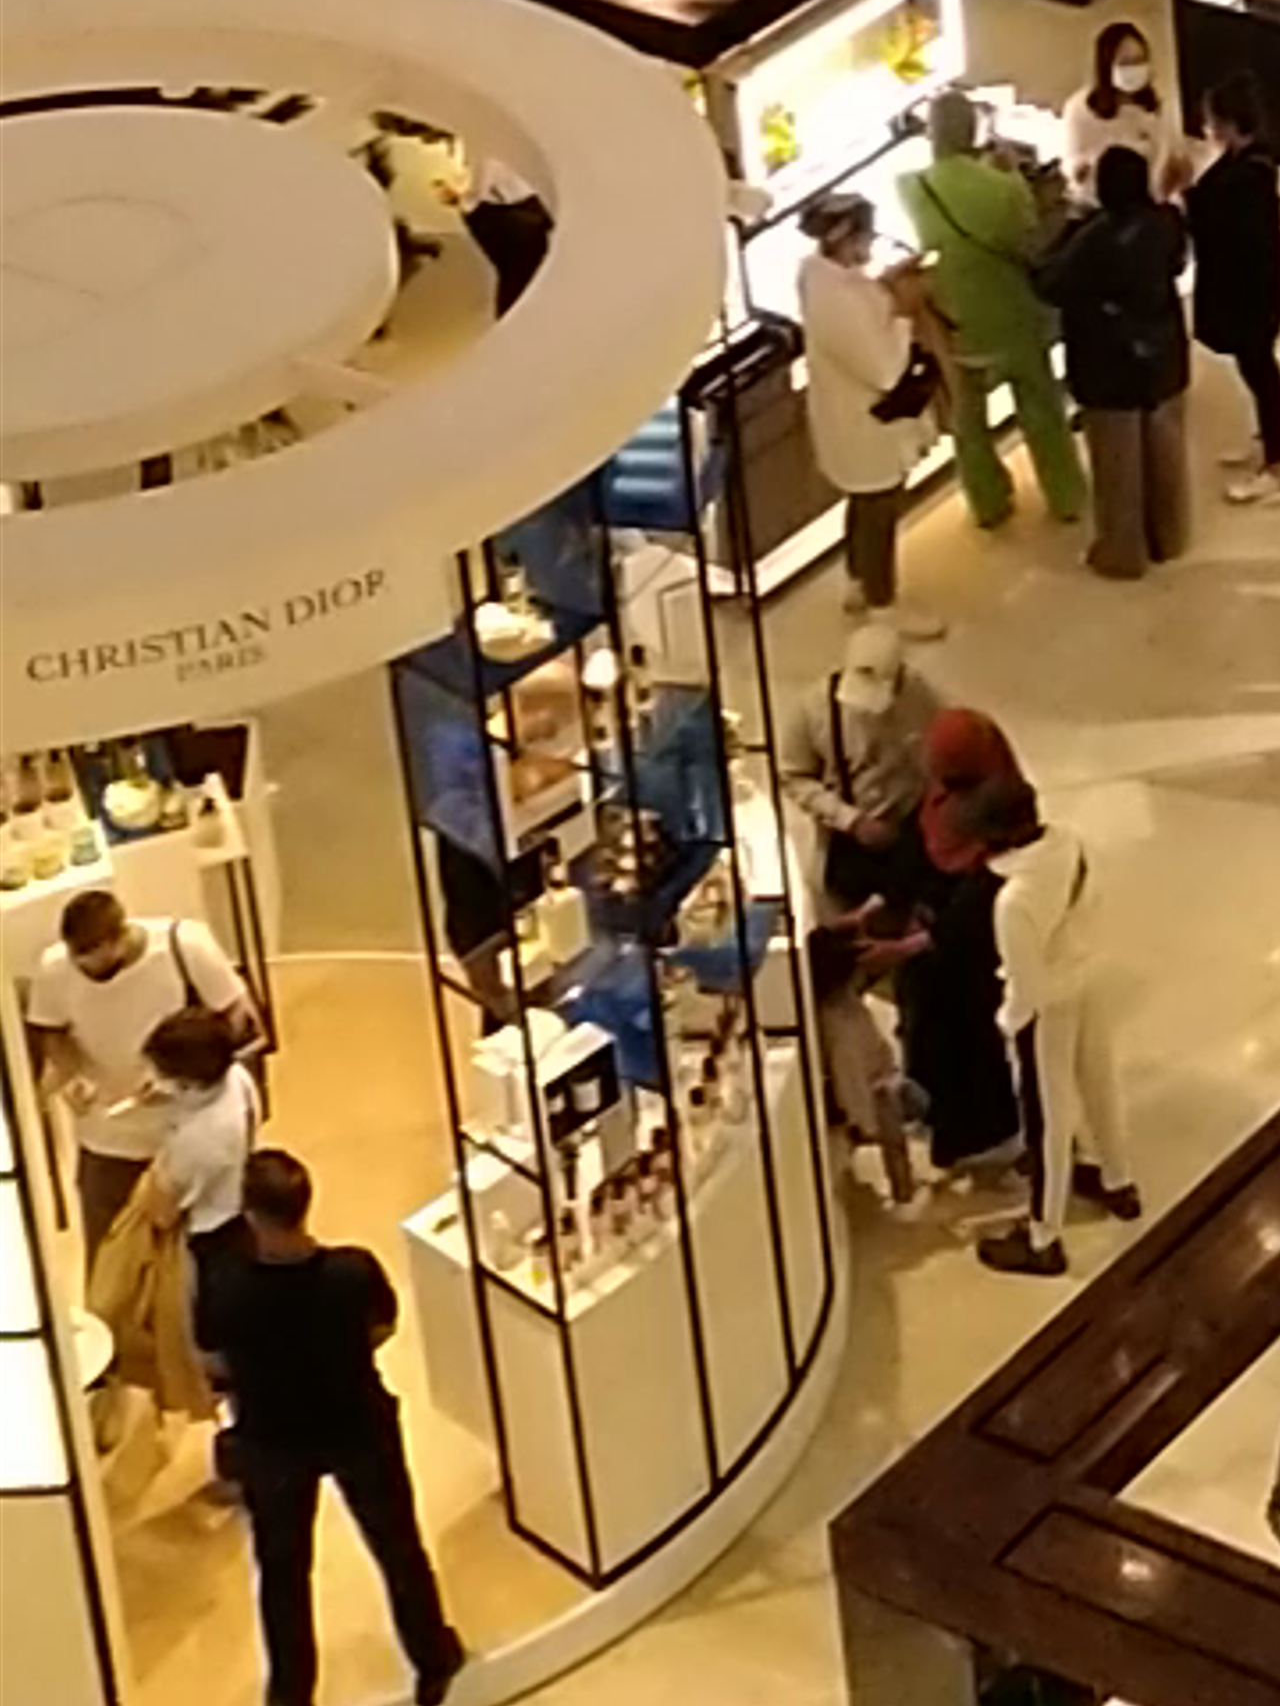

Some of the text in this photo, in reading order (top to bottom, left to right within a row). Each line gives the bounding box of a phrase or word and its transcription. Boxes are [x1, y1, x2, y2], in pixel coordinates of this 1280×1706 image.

[26, 569, 386, 683] CHRISTIAN DIOR
[175, 643, 267, 682] PARIS
